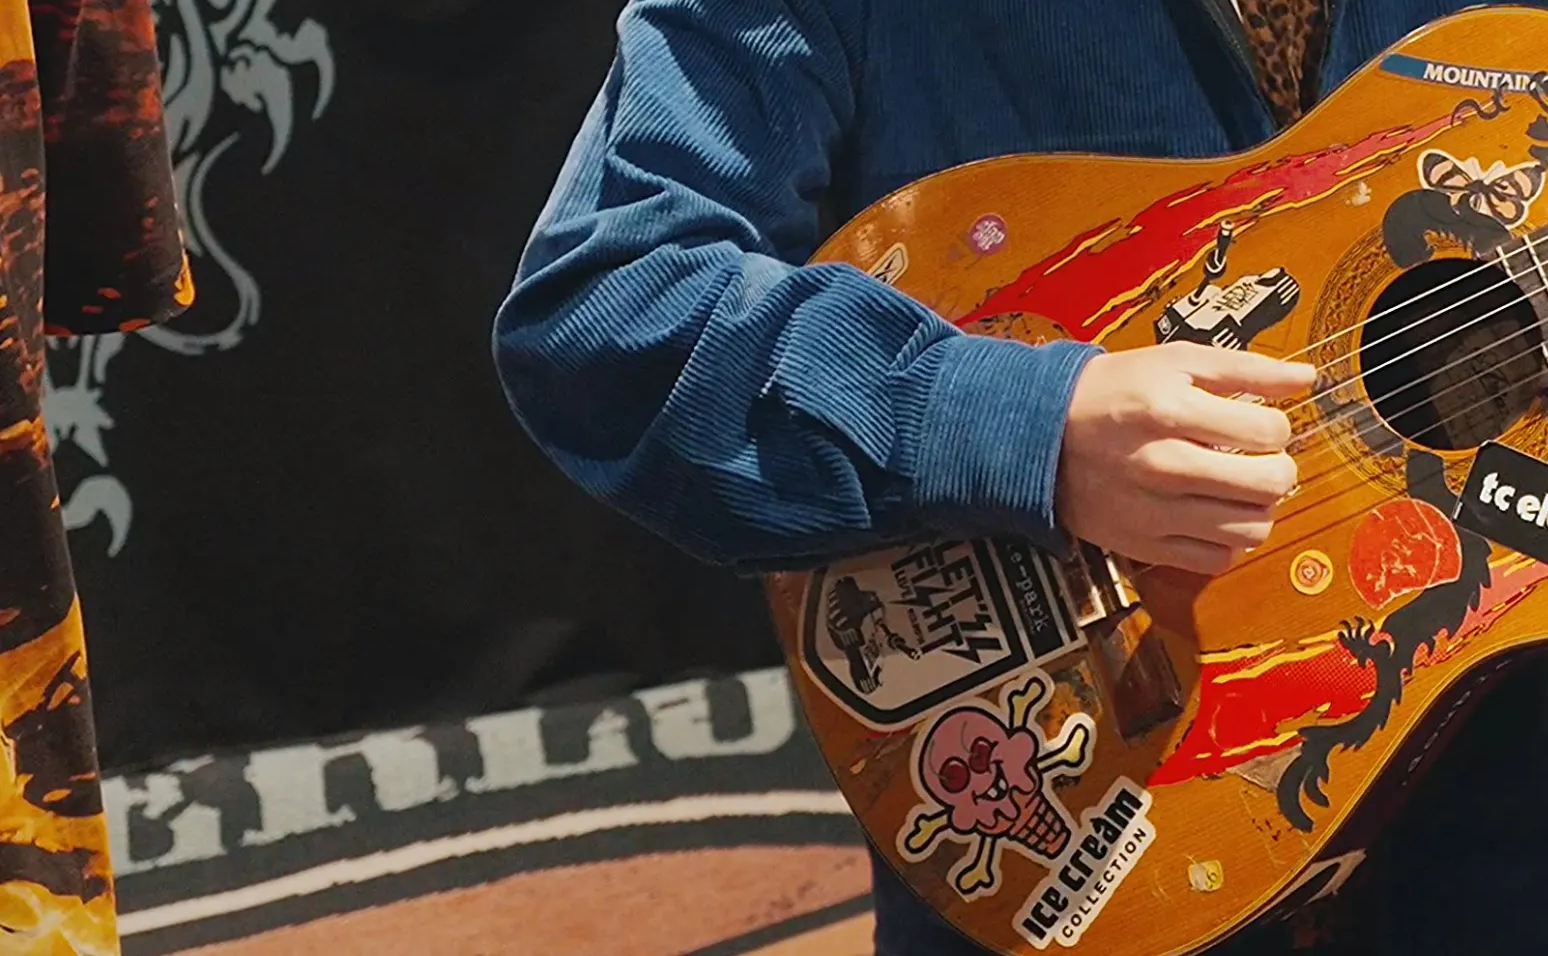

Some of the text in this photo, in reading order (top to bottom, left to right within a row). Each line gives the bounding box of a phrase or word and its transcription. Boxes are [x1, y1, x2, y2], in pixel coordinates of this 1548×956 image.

[1423, 62, 1536, 92] MOUNTAIN
[1479, 472, 1515, 512] tc
[1062, 828, 1147, 939] COLLECTION
